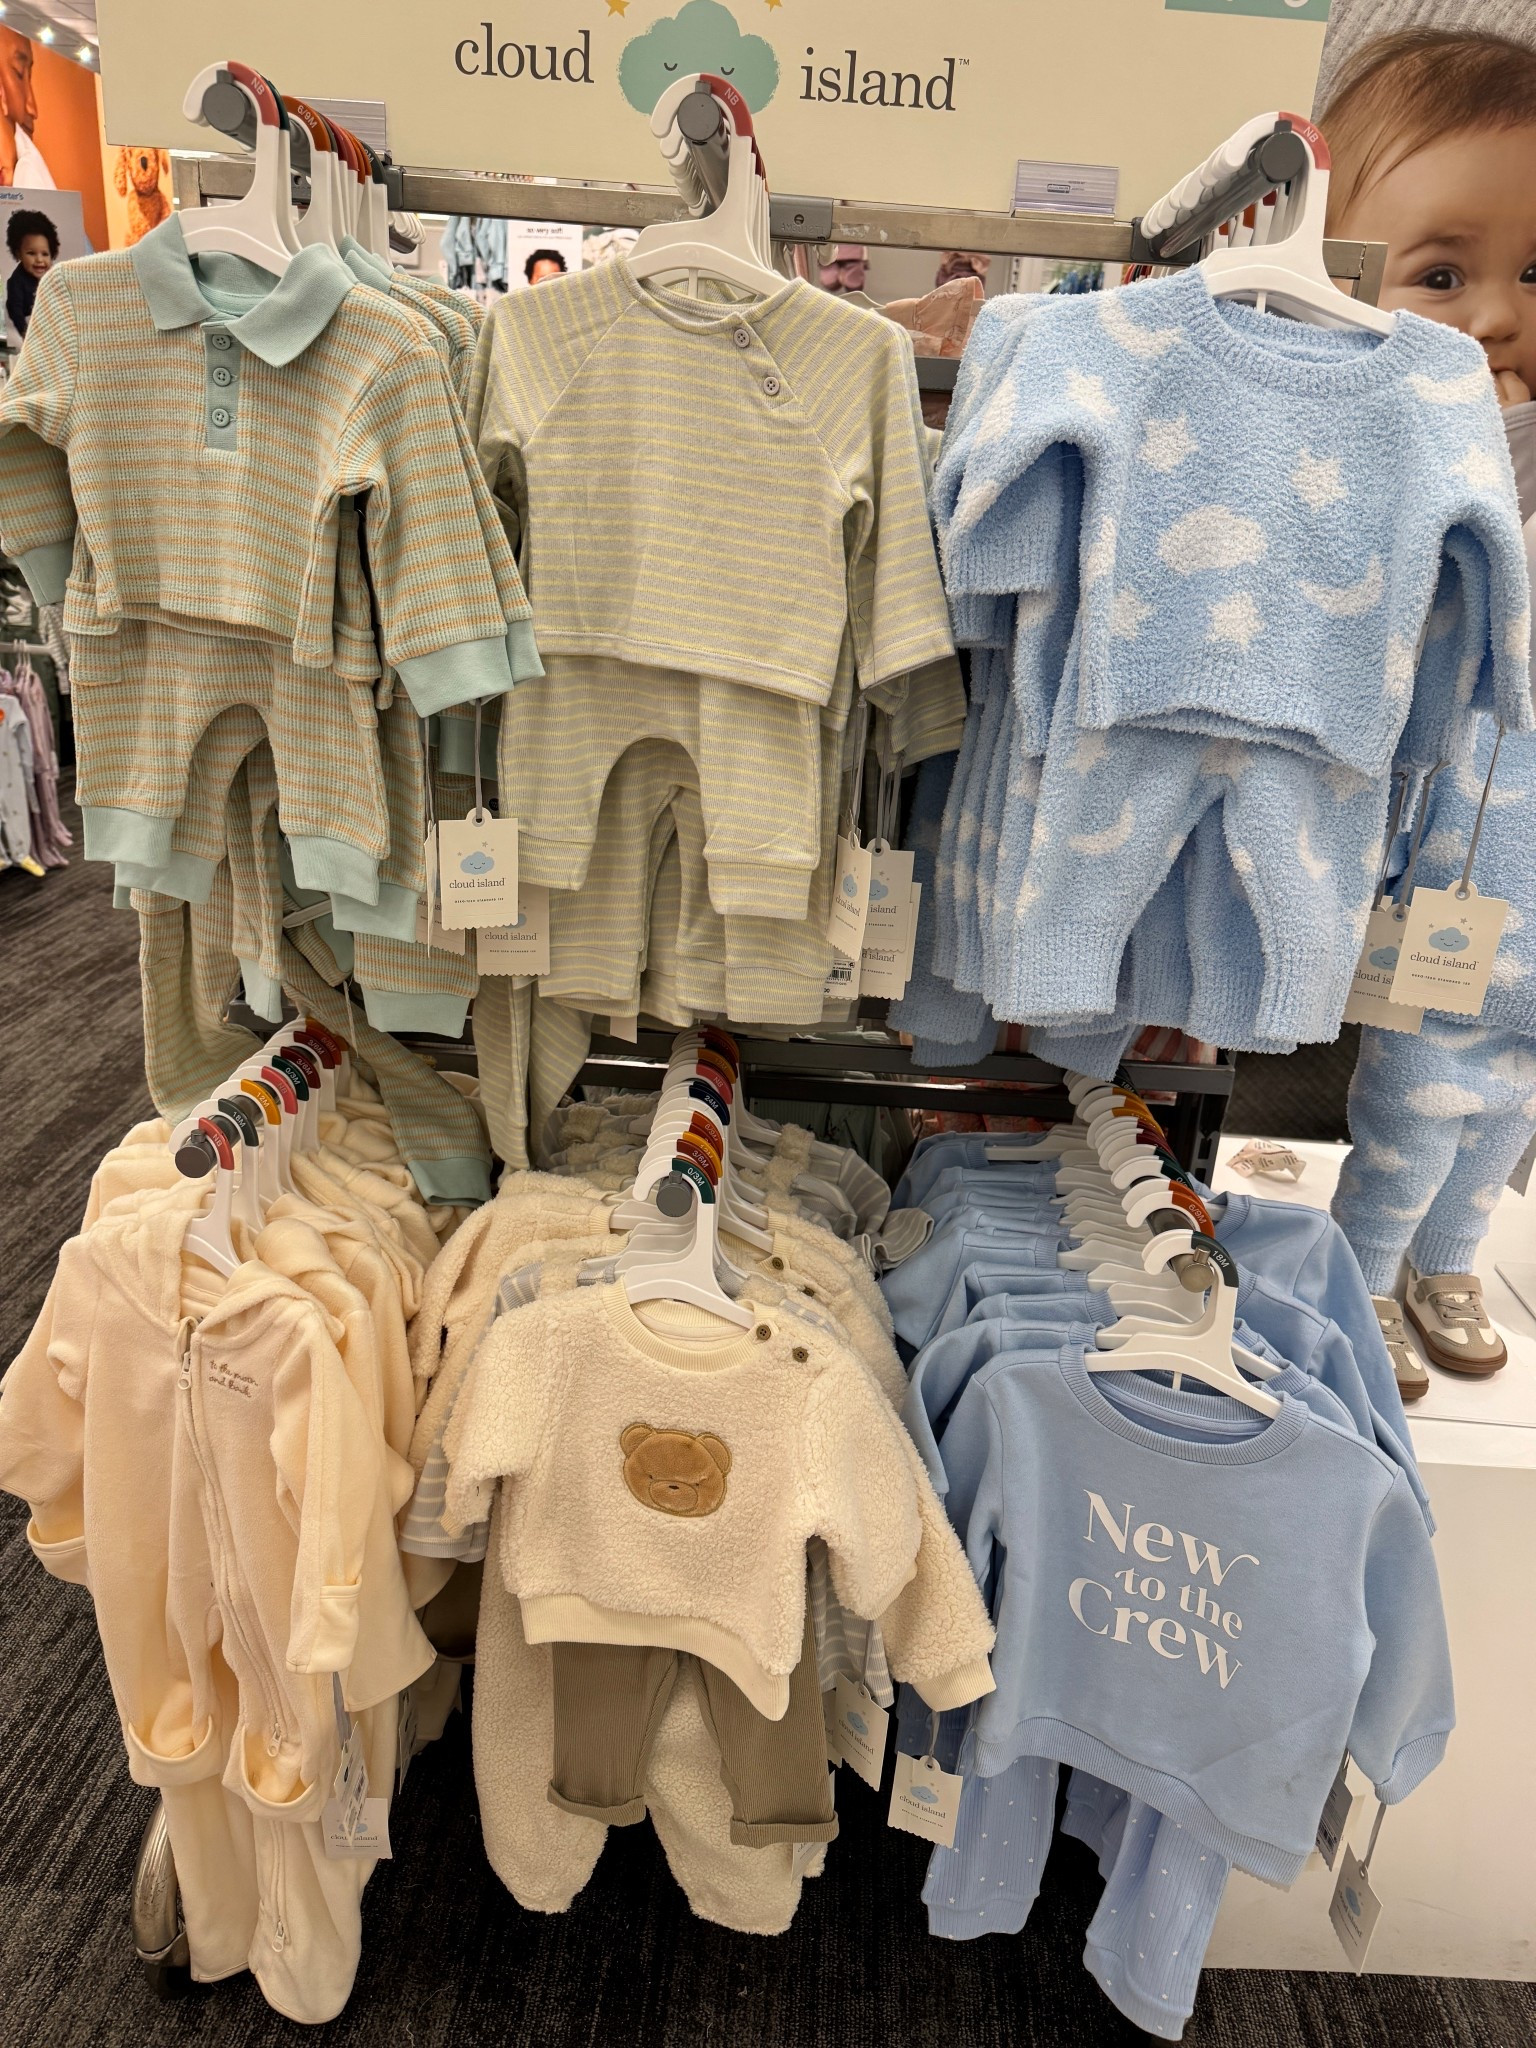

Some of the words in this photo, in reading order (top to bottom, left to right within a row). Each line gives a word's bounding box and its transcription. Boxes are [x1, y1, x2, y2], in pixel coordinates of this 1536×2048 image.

[454, 22, 595, 84] cloud
[251, 77, 265, 95] NB
[724, 88, 740, 106] NB
[297, 105, 318, 128] 6/9M
[1303, 126, 1319, 143] NB
[0, 192, 24, 200] arter's
[449, 879, 475, 889] cloud
[477, 877, 505, 888] island
[870, 904, 897, 914] island
[484, 931, 509, 940] cloud
[510, 932, 537, 941] island
[868, 951, 896, 963] island
[1410, 951, 1441, 965] cloud
[1354, 969, 1380, 983] cloud
[296, 1058, 313, 1076] 3/6M
[285, 1067, 300, 1086] 0/3M
[714, 1076, 724, 1088] NB
[278, 1083, 288, 1094] NB
[256, 1091, 270, 1108] 12M
[704, 1095, 719, 1110] 24M
[233, 1111, 247, 1128] 18M
[212, 1134, 223, 1147] NB
[692, 1150, 709, 1169] 3/6M
[687, 1167, 705, 1188] 0/3M
[1188, 1203, 1207, 1224] 6/9M
[1212, 1250, 1230, 1268] 18M
[1082, 1488, 1260, 1587] New
[1114, 1567, 1166, 1601] to
[1178, 1584, 1243, 1639] the
[1068, 1577, 1243, 1690] Crew
[899, 1795, 920, 1809] cloud
[921, 1801, 946, 1819] island
